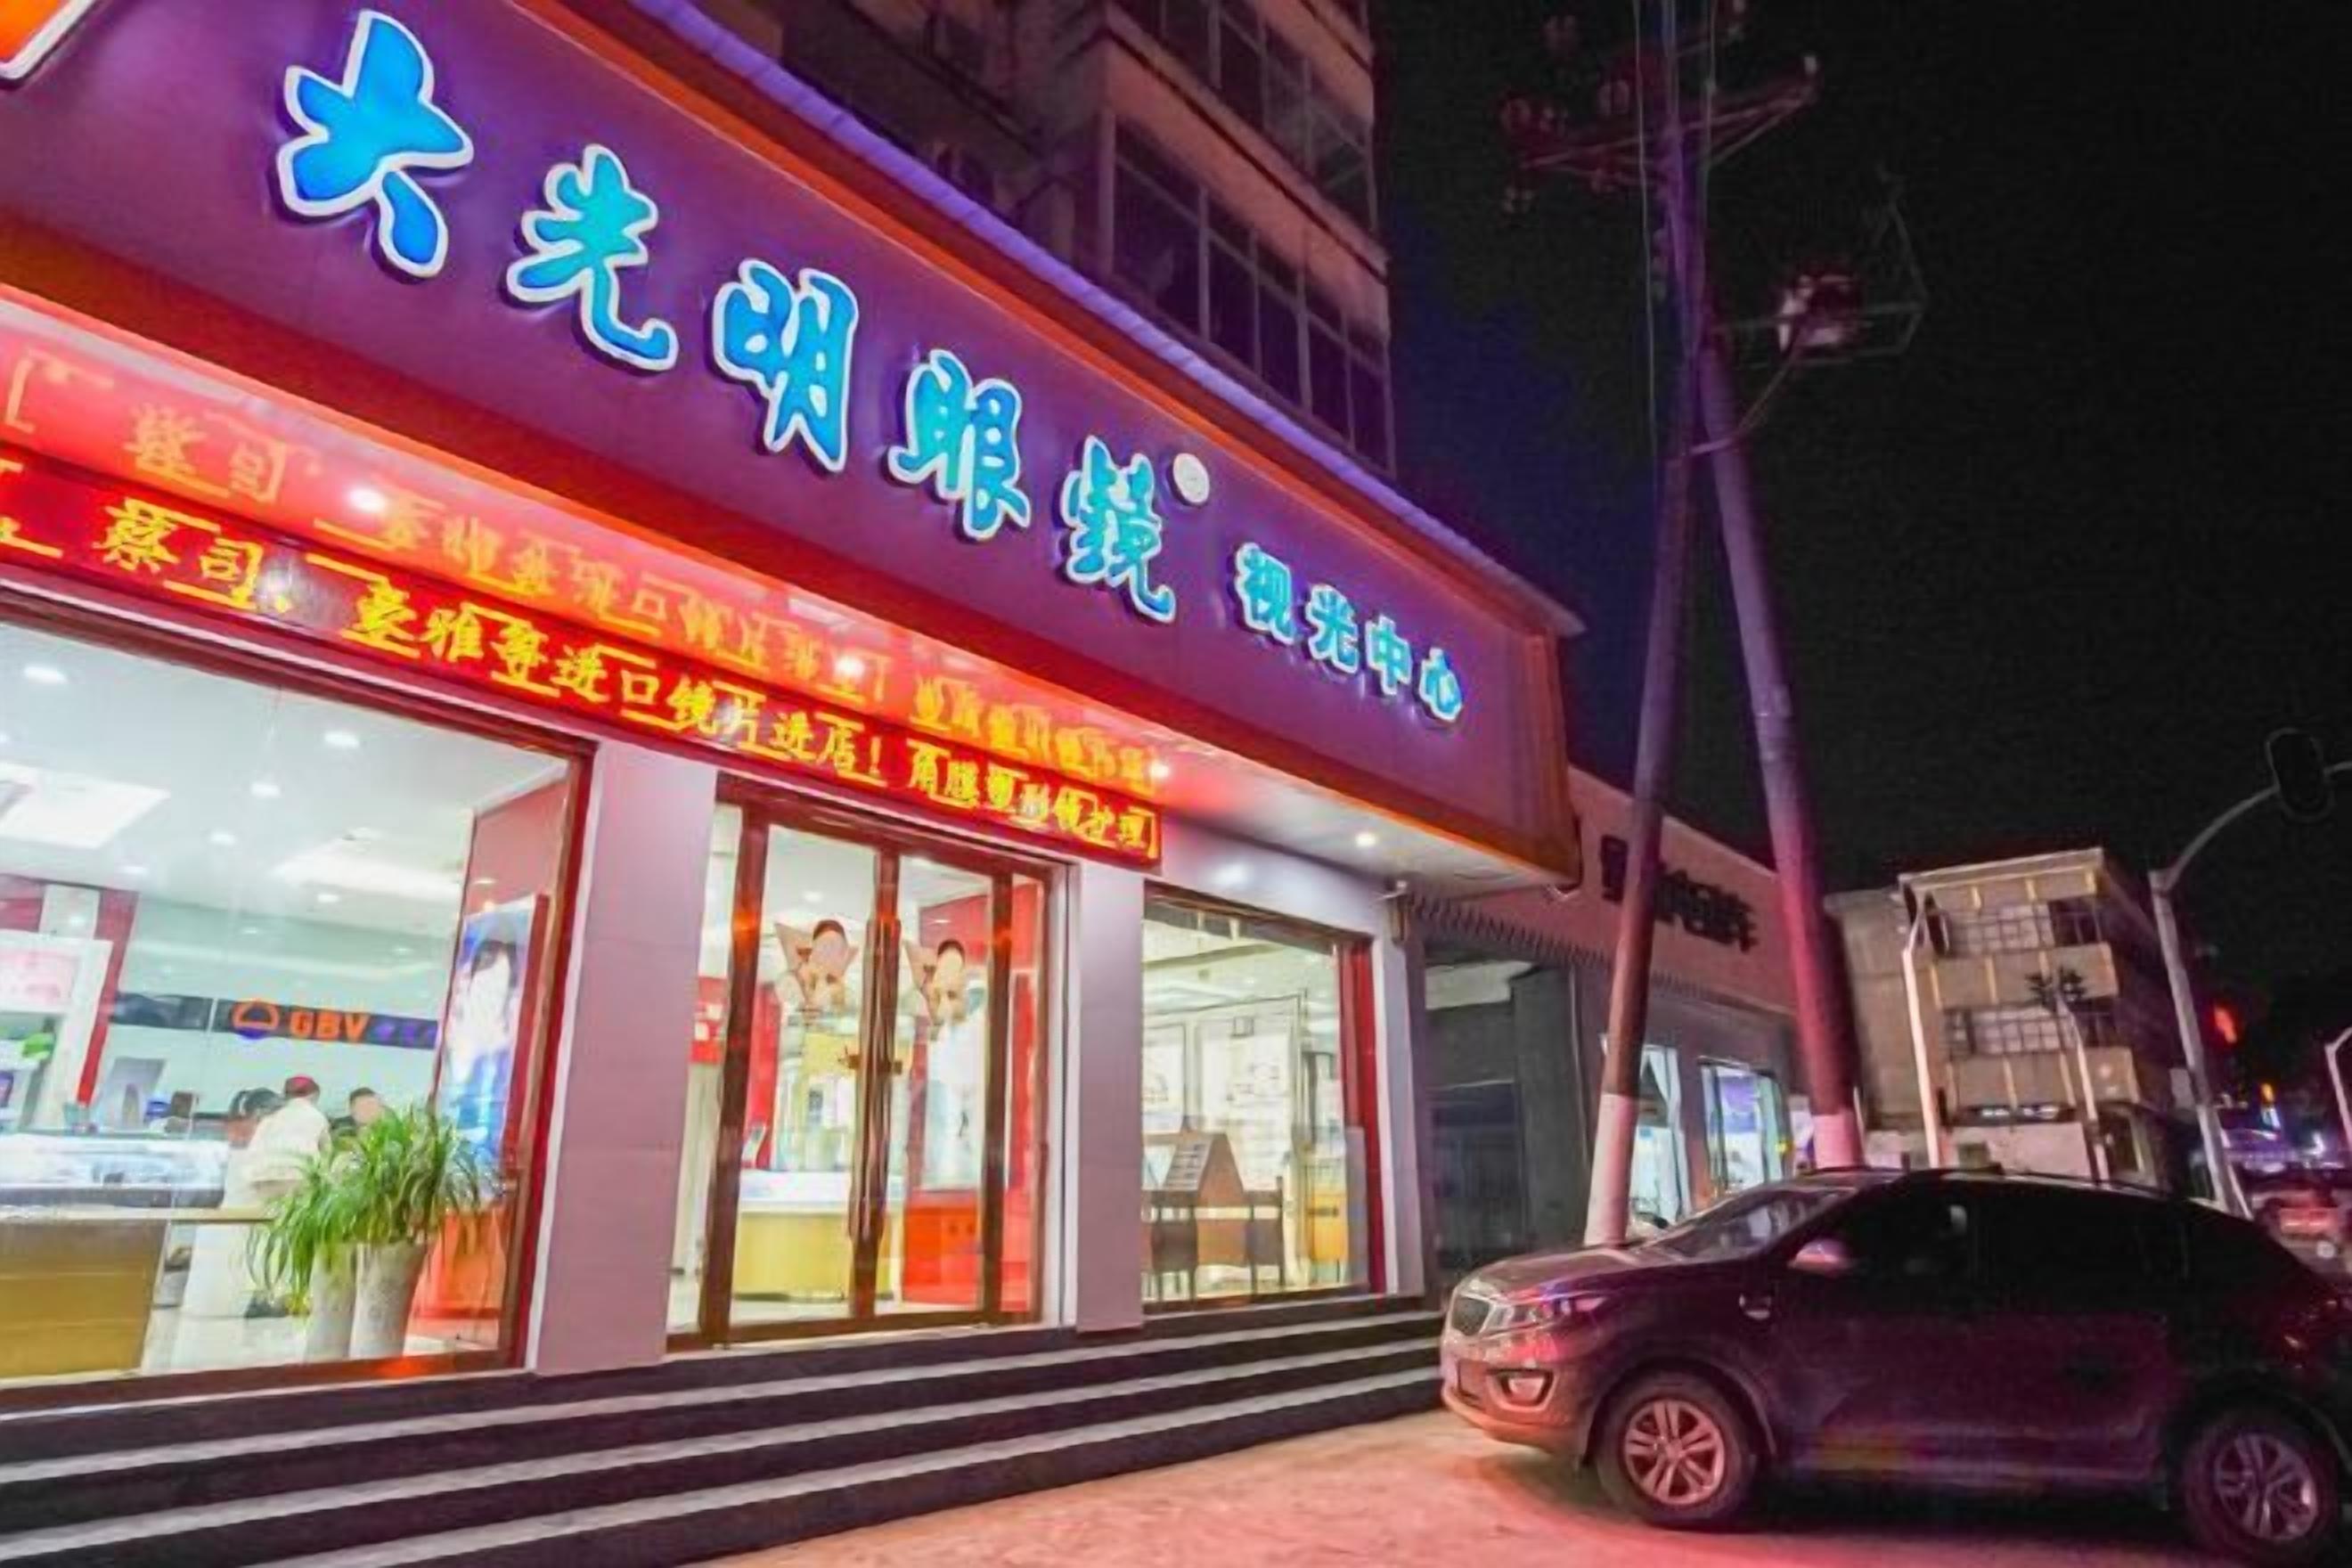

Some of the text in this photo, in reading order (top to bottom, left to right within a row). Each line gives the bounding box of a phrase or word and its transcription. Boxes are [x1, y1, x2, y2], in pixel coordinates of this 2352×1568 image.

[274, 9, 1178, 624] 大光明眼镜
[1234, 541, 1463, 723] 视光中心
